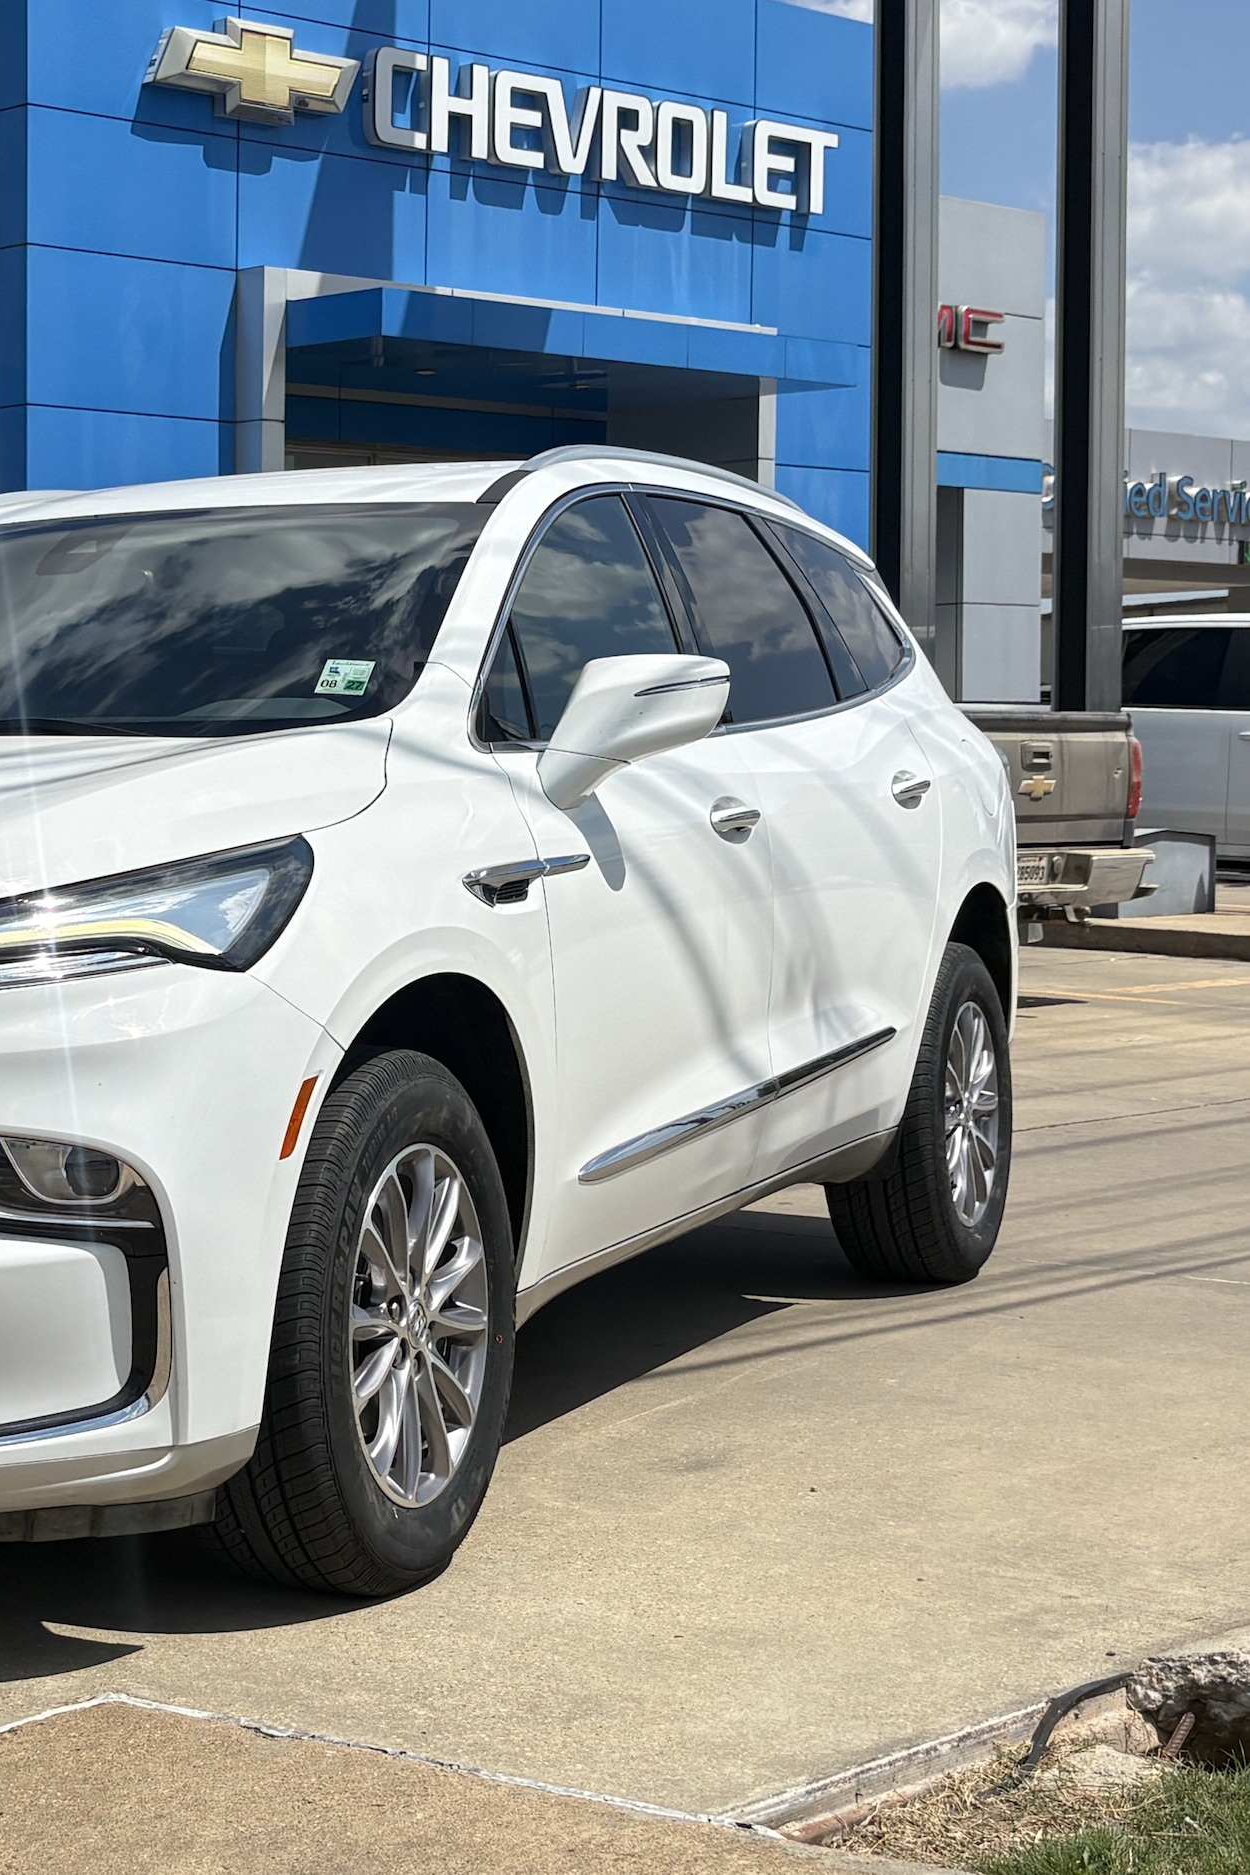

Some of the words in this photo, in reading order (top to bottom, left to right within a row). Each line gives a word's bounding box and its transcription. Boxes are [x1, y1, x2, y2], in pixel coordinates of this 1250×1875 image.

[363, 46, 839, 214] CHEVROLET
[1176, 475, 1250, 526] Servi
[320, 679, 338, 688] 08
[347, 680, 366, 691] 27
[330, 1284, 344, 1398] TIGER
[339, 1174, 363, 1256] PAW
